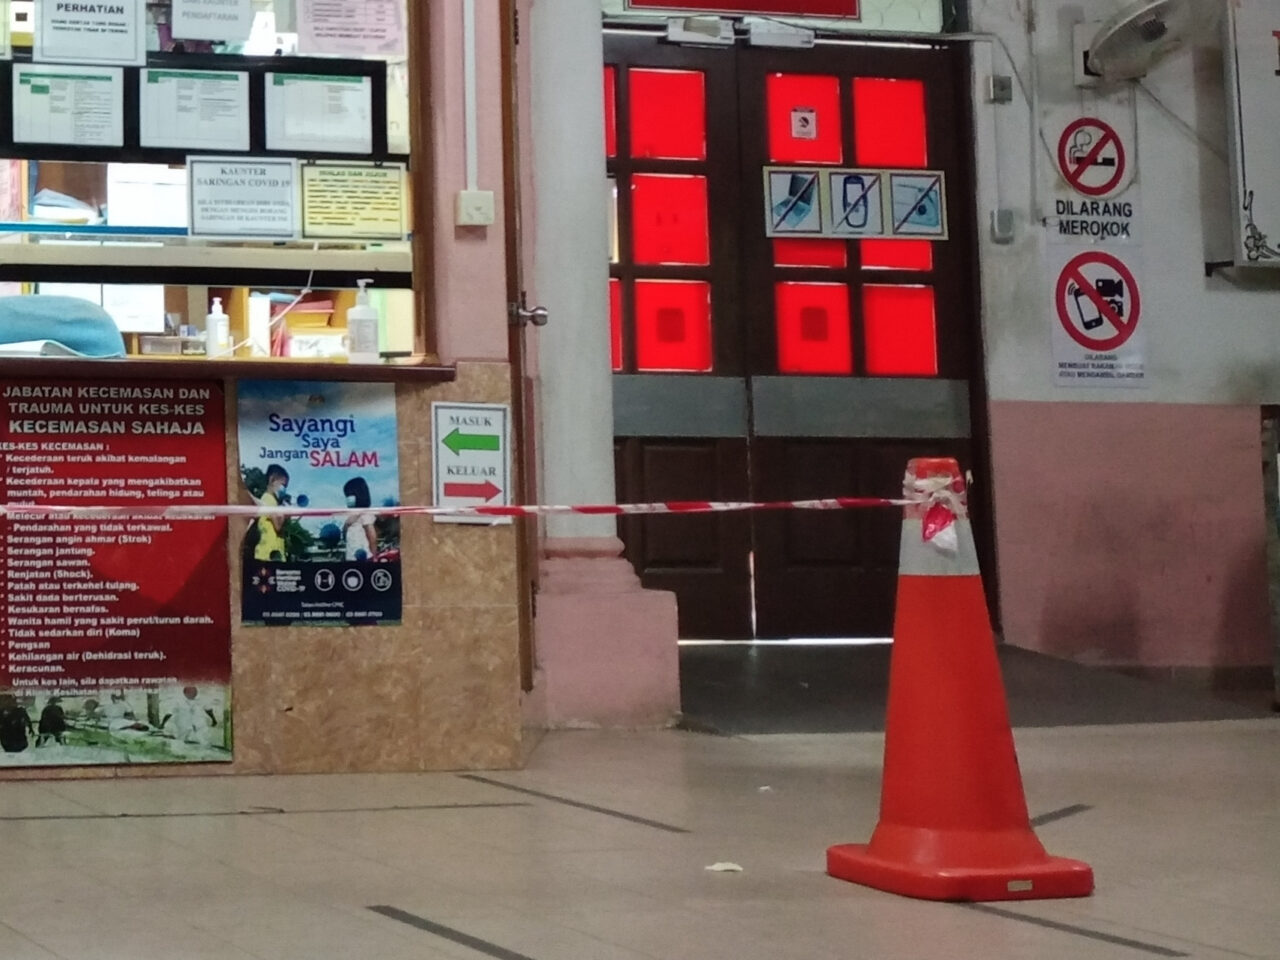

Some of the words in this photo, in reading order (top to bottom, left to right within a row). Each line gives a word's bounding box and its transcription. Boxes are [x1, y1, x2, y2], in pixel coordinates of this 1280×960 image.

[56, 3, 125, 15] PERHATIAN
[220, 167, 267, 176] KAUNTER
[197, 177, 246, 186] SARINGAN
[247, 179, 279, 188] COVID
[1056, 199, 1133, 218] DILARANG
[1059, 219, 1130, 237] MEROKOK
[2, 386, 73, 398] JABATAN
[77, 387, 173, 399] KECEMASAN
[179, 389, 210, 400] DAN
[8, 402, 74, 414] TRAUMA
[79, 403, 134, 414] UNTUK
[138, 404, 205, 416] KES-KES
[269, 412, 356, 437] Sayangi
[449, 415, 493, 428] MASUK
[9, 420, 126, 434] KECEMASAN
[131, 421, 205, 435] SAHAJA
[41, 442, 104, 451] KECEMASAN
[302, 434, 341, 451] Saya
[5, 454, 65, 462] Kecederaan
[67, 454, 93, 462] teruk
[95, 454, 126, 462] akibat
[127, 455, 187, 465] kemalangan
[259, 448, 309, 462] Jangan
[309, 451, 380, 468] SALAM
[446, 464, 497, 477] KELUAR
[6, 477, 65, 485] Kecederaan
[66, 477, 99, 487] kepala
[102, 478, 125, 487] yang
[127, 478, 202, 487] mengakibatkan
[49, 489, 107, 498] pendarahan
[146, 489, 180, 499] telinga
[13, 523, 71, 532] Pendarahan
[73, 524, 97, 533] yang
[99, 523, 124, 531] tidak
[7, 535, 54, 545] Serangan
[55, 535, 83, 545] angin
[85, 535, 116, 543] ahmar
[7, 547, 54, 557] Serangan
[7, 558, 54, 568] Serangan
[7, 570, 52, 580] Renjatan
[7, 581, 36, 590] Patah
[38, 582, 60, 590] atau
[7, 593, 33, 602] Sakit
[35, 593, 60, 602] dada
[7, 605, 61, 614] Kesukaran
[7, 617, 42, 626] Wanita
[44, 616, 72, 625] hamil
[74, 618, 98, 627] yang
[100, 616, 125, 625] sakit
[8, 628, 36, 637] Tidak
[38, 628, 84, 637] sedarkan
[86, 628, 103, 637] diri
[8, 641, 51, 651] Pengsan
[8, 652, 64, 662] Kehilangan
[66, 652, 80, 660] air
[12, 677, 39, 686] Untuk
[41, 677, 57, 686] kes
[80, 677, 97, 685] sila
[98, 677, 139, 686] dapatkan
